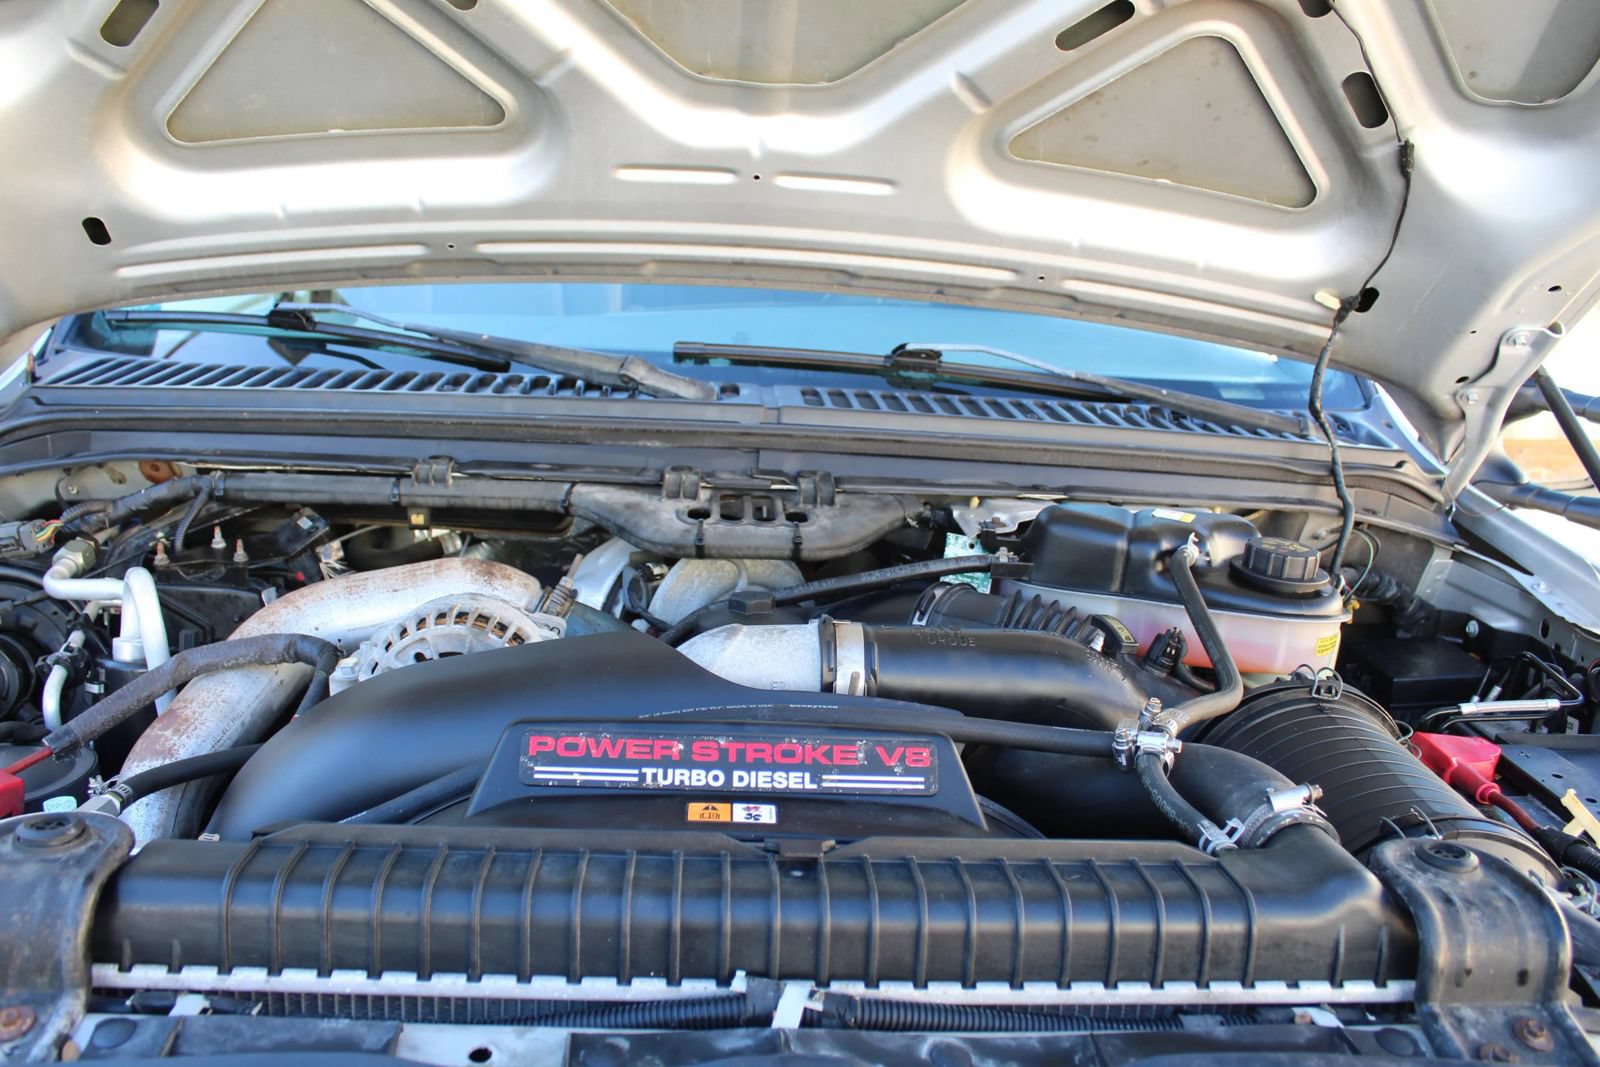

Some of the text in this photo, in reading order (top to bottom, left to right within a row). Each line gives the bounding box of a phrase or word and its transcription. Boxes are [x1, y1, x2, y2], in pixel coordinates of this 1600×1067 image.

[528, 735, 932, 768] POWER STROKE V8
[641, 767, 818, 790] TURBO DIESEL
